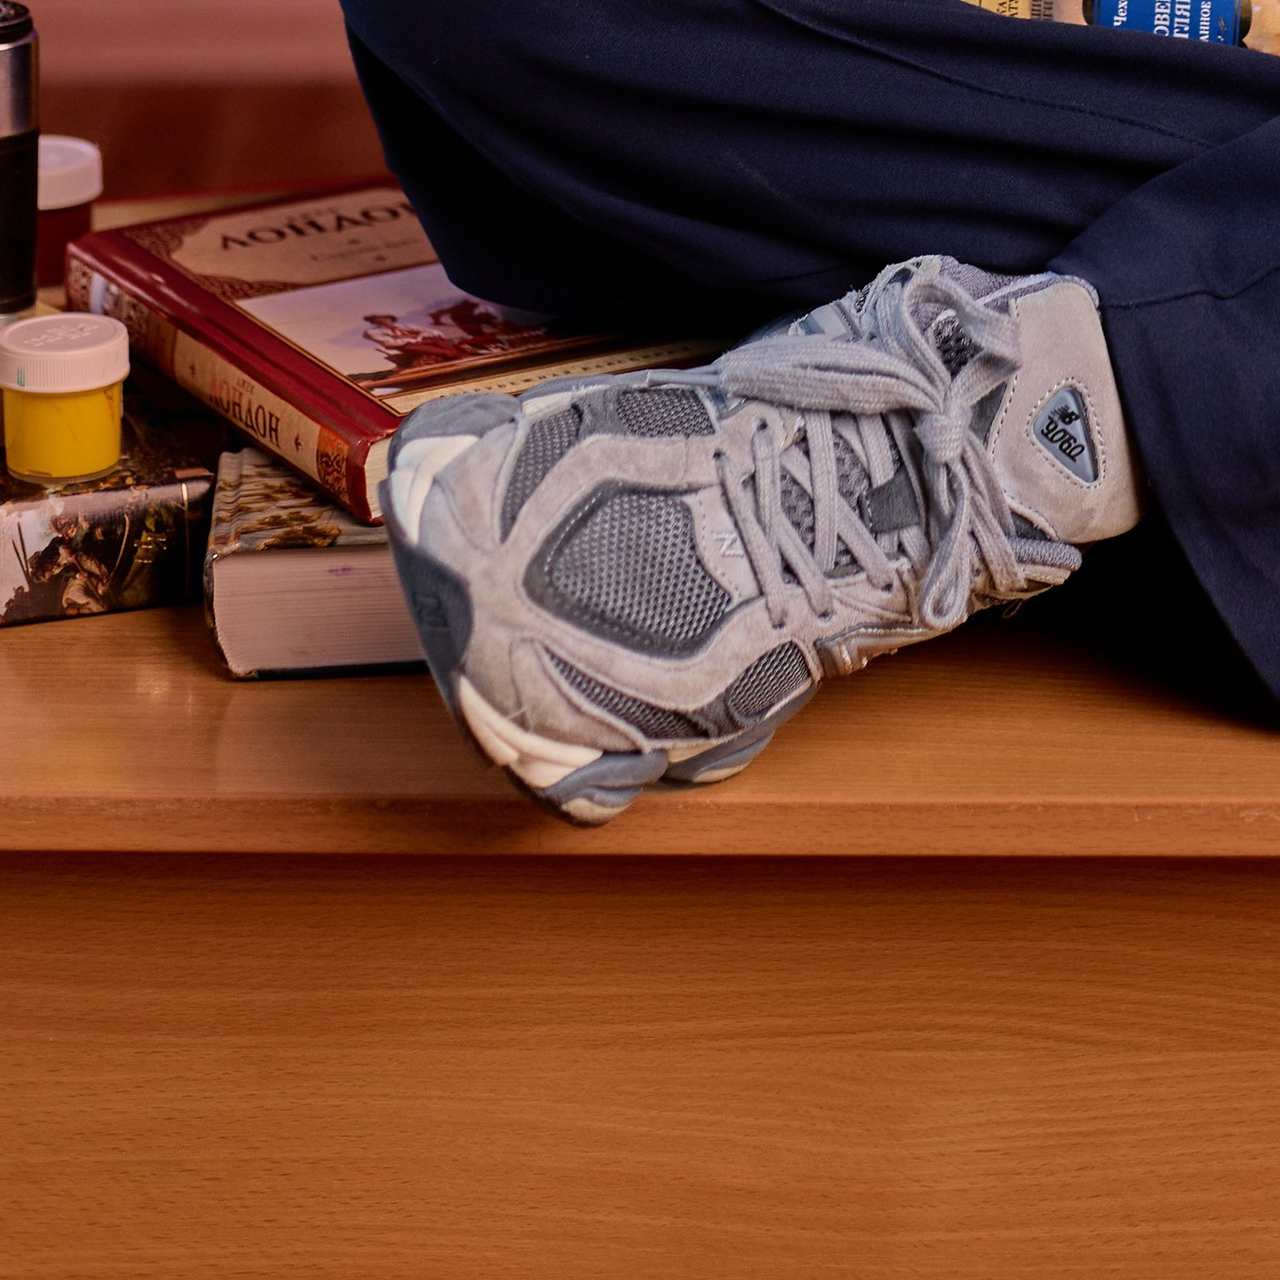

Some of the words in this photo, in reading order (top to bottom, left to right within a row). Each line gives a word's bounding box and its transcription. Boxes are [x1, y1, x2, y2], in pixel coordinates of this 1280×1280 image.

[1199, 0, 1212, 42] АННОЕ
[208, 377, 280, 449] ЛОНДОН
[1040, 415, 1086, 464] 9060
